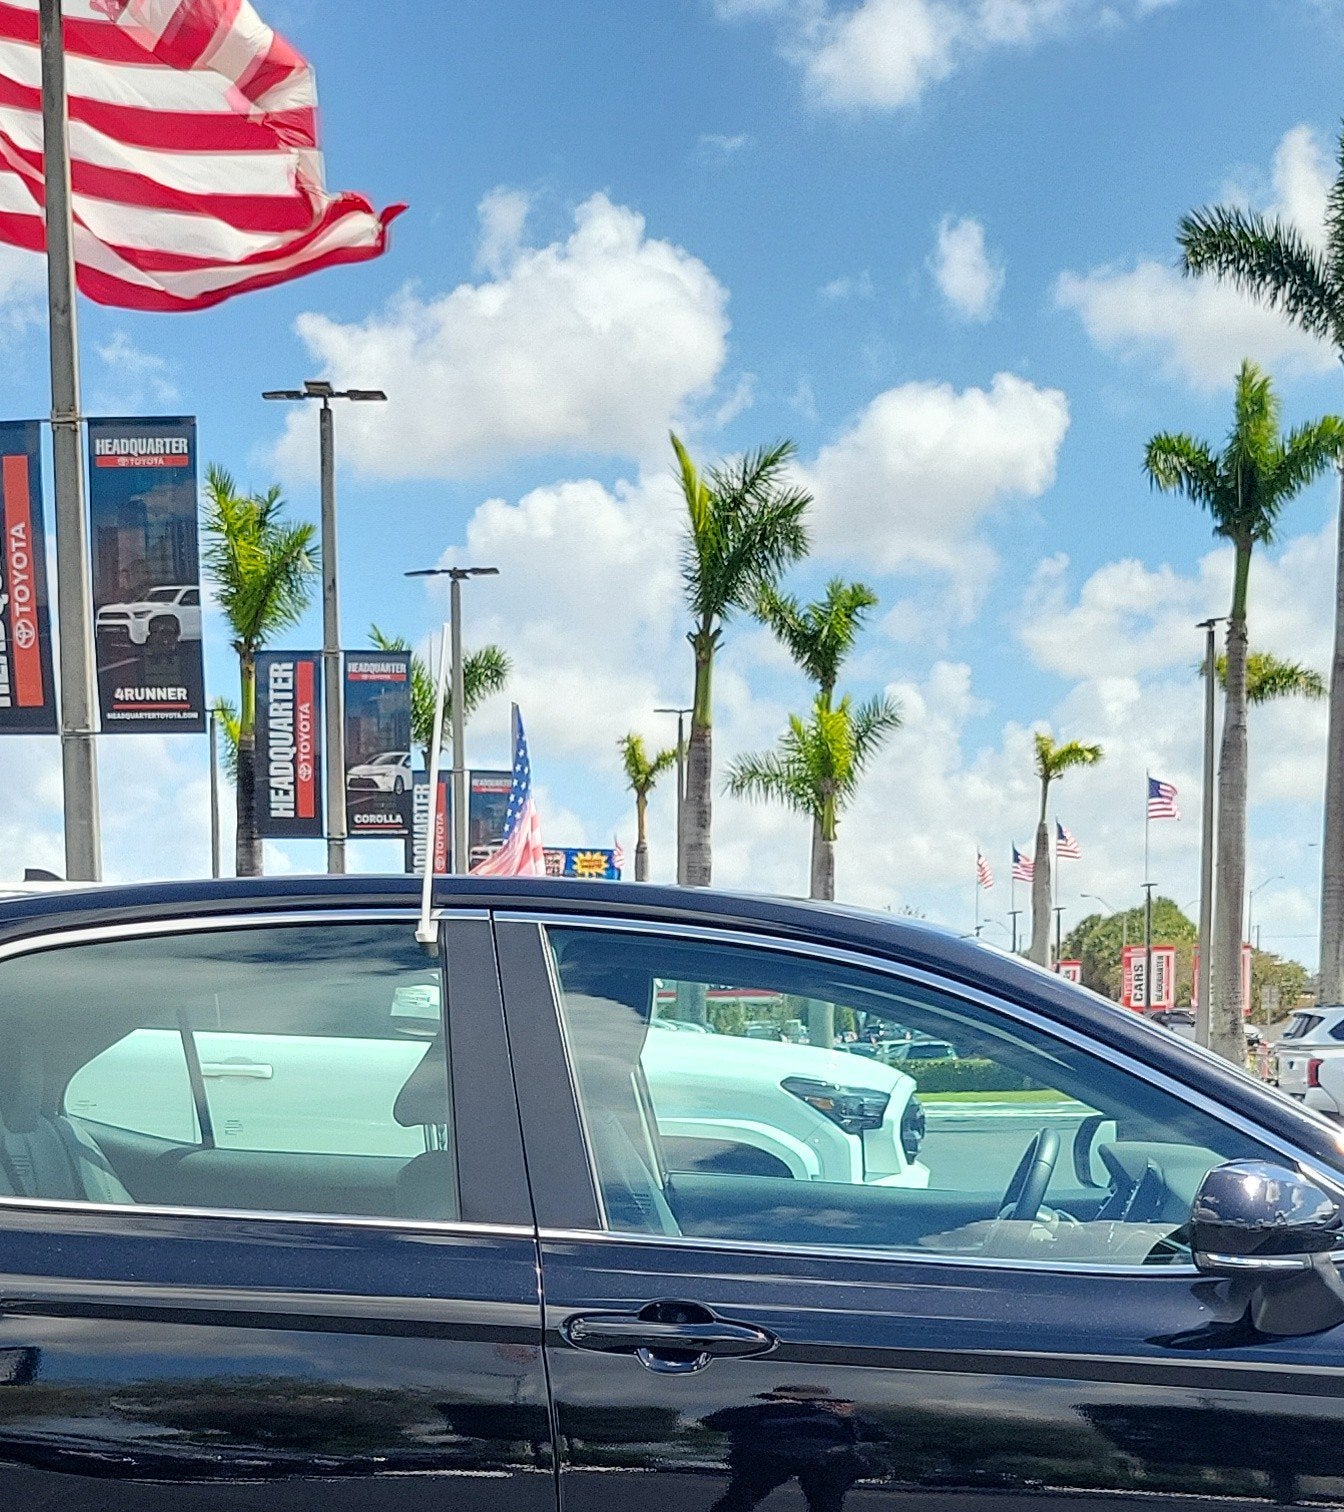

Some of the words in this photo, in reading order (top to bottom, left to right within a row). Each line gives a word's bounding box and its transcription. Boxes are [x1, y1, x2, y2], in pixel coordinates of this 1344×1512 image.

[96, 438, 188, 456] HEADQUARTER
[131, 458, 164, 466] TOYOTA
[10, 522, 34, 616] TOYOTA
[348, 662, 406, 674] HEADQUARTER
[114, 687, 187, 701] 4RUNNER
[268, 662, 296, 818] HEADQUARTER
[299, 703, 311, 760] TOYOTA
[354, 814, 402, 824] COROLLA
[435, 813, 444, 855] TOYOTA
[1133, 964, 1144, 1001] CARS
